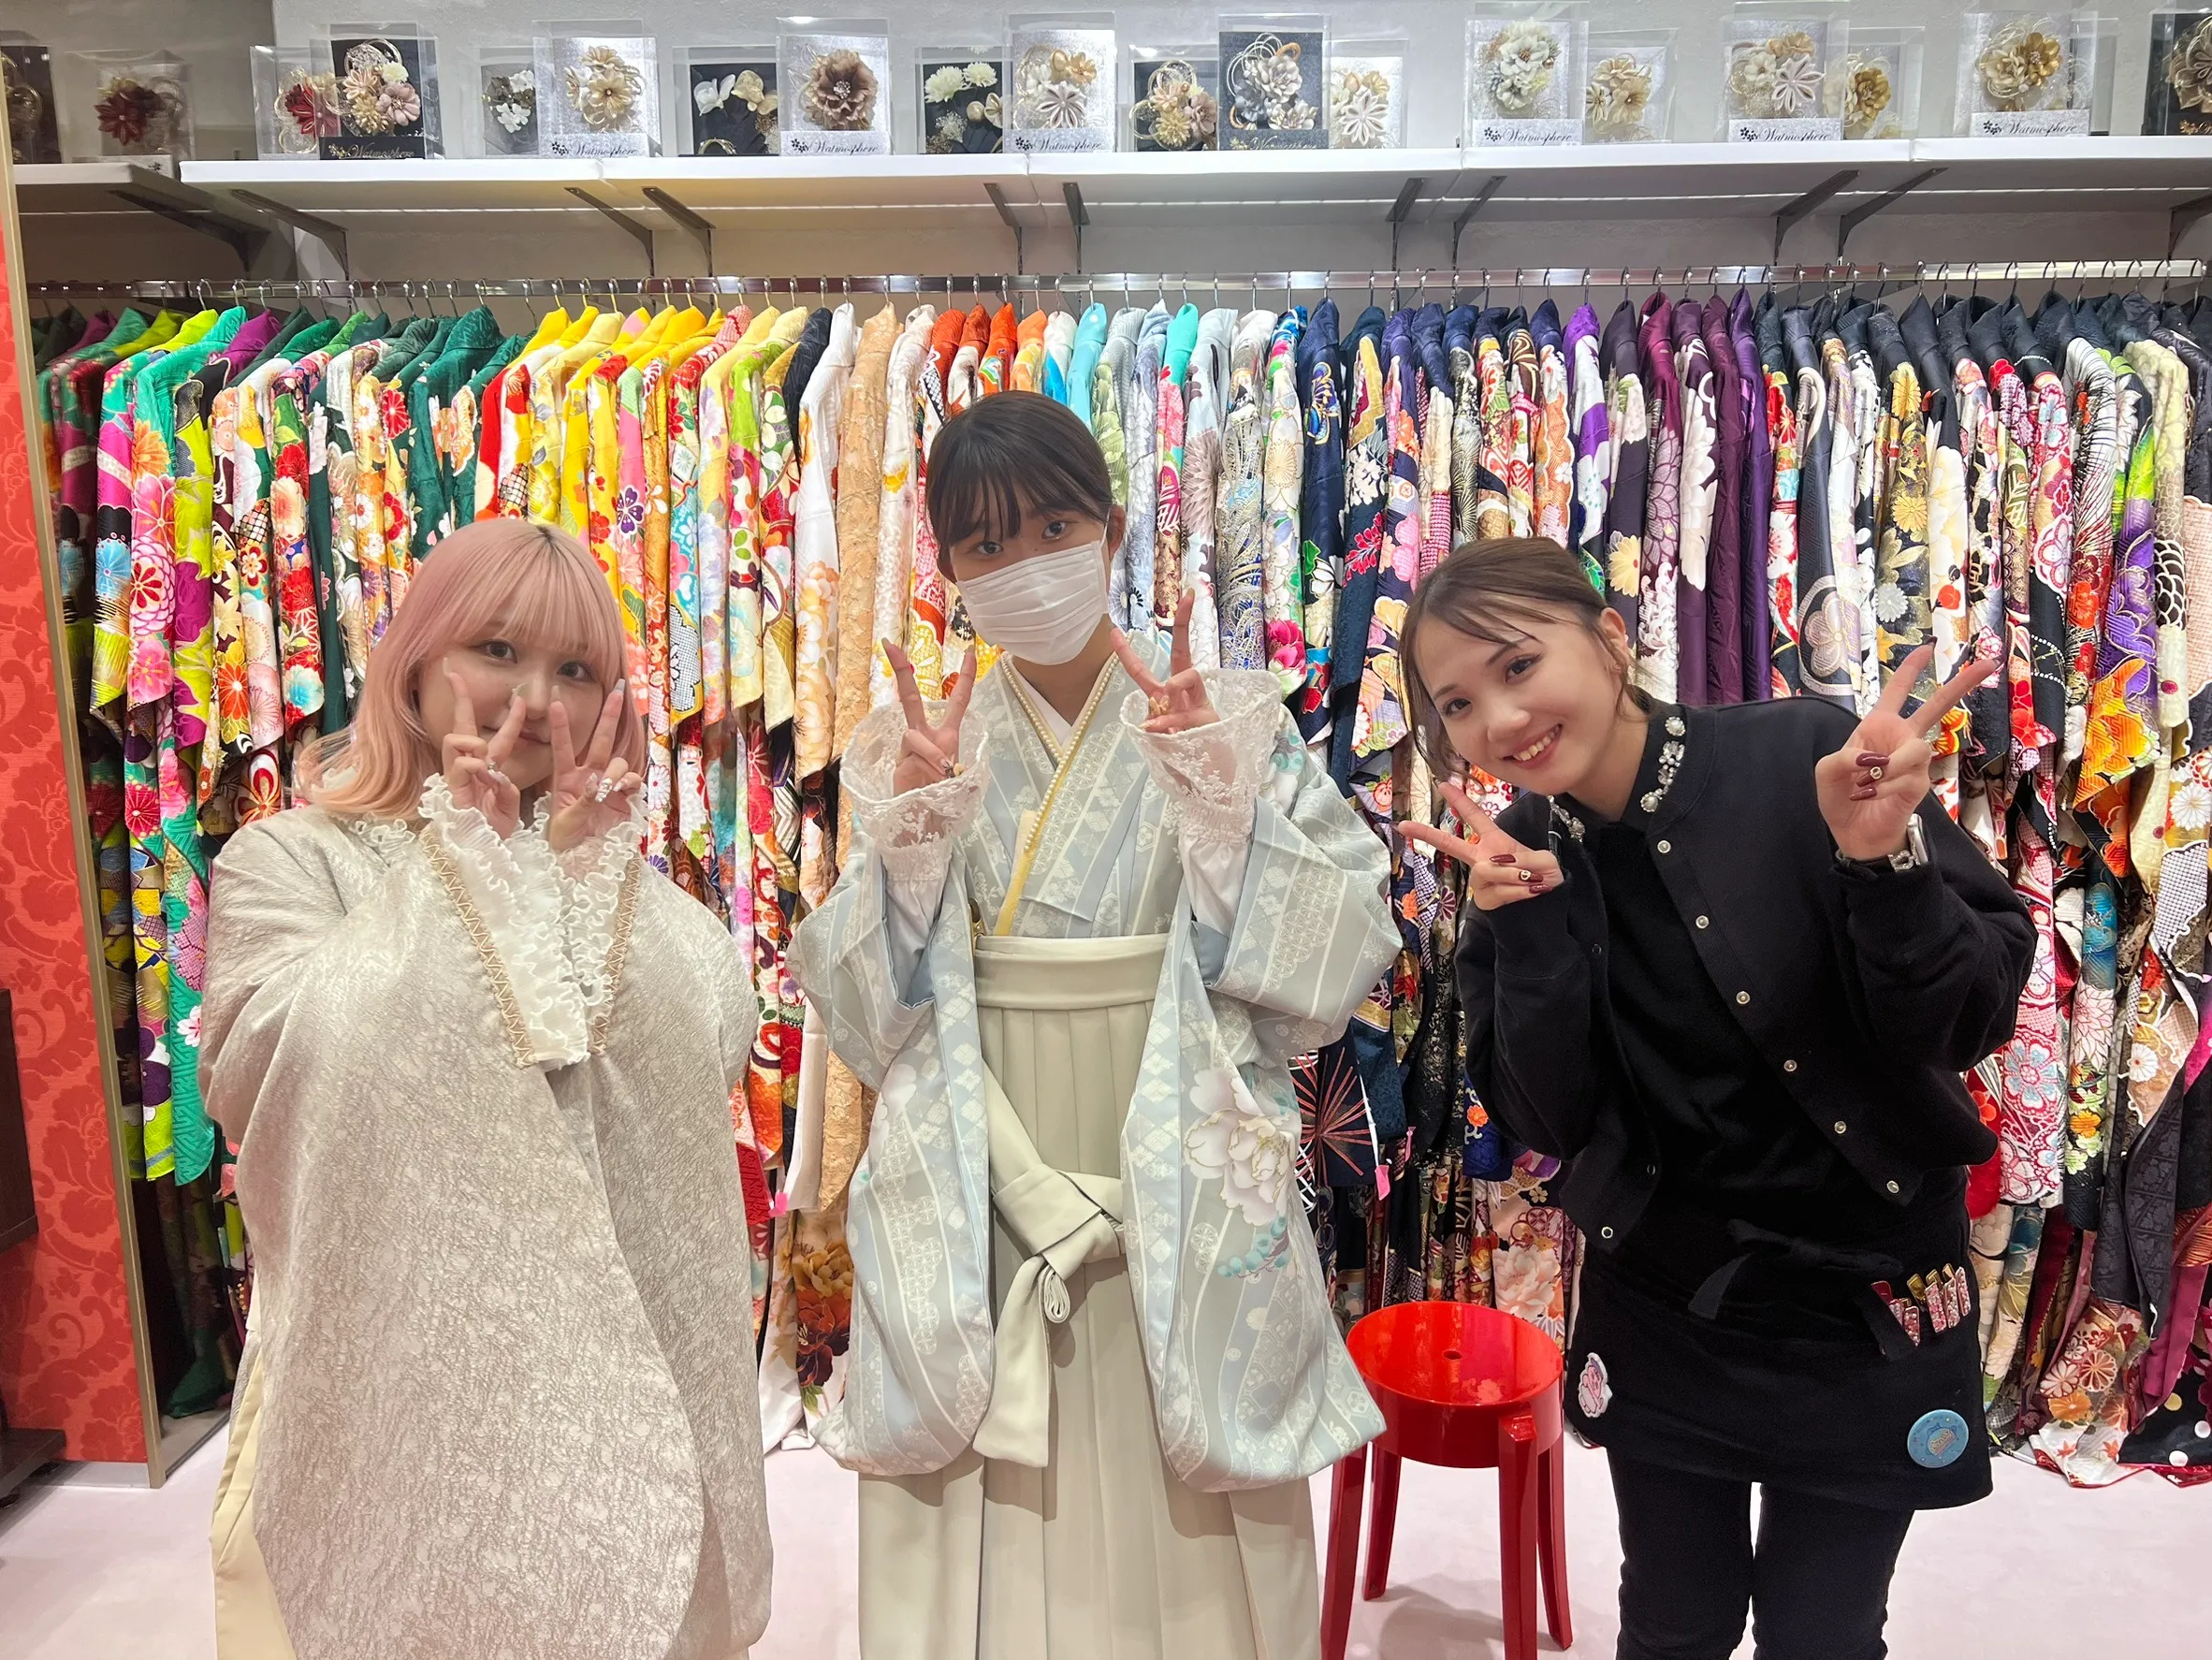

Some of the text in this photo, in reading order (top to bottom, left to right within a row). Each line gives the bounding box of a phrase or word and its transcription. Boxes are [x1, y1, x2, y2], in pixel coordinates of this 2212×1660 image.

[1501, 128, 1573, 146] Watmosphere
[2003, 120, 2077, 137] Watmosphere
[808, 138, 878, 155] Watmosphere
[1032, 137, 1102, 153] Watmosphere
